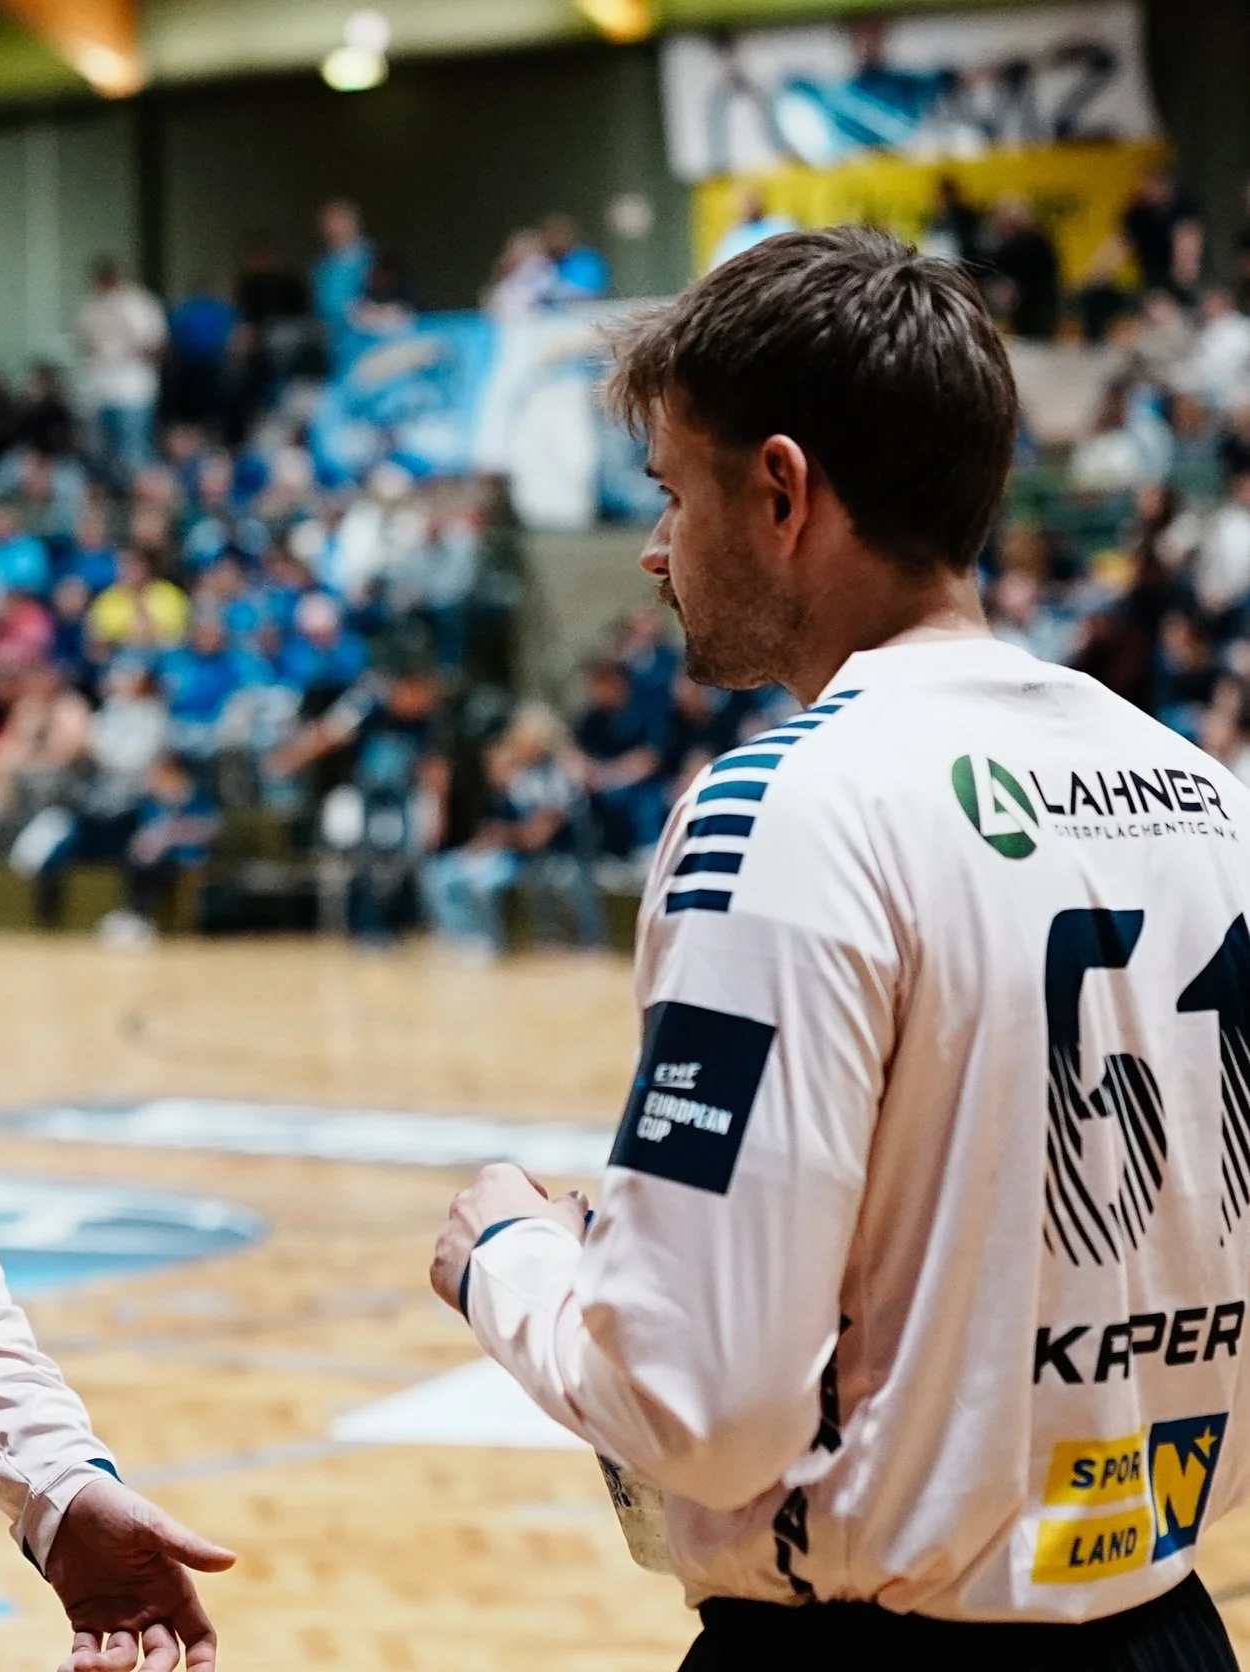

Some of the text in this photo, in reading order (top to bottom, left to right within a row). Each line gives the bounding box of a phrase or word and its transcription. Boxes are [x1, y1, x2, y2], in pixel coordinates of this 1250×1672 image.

[1029, 768, 1230, 820] LAHNER
[636, 1114, 673, 1143] CUP
[1070, 1450, 1142, 1488] SPOR
[1069, 1526, 1138, 1568] LAND
